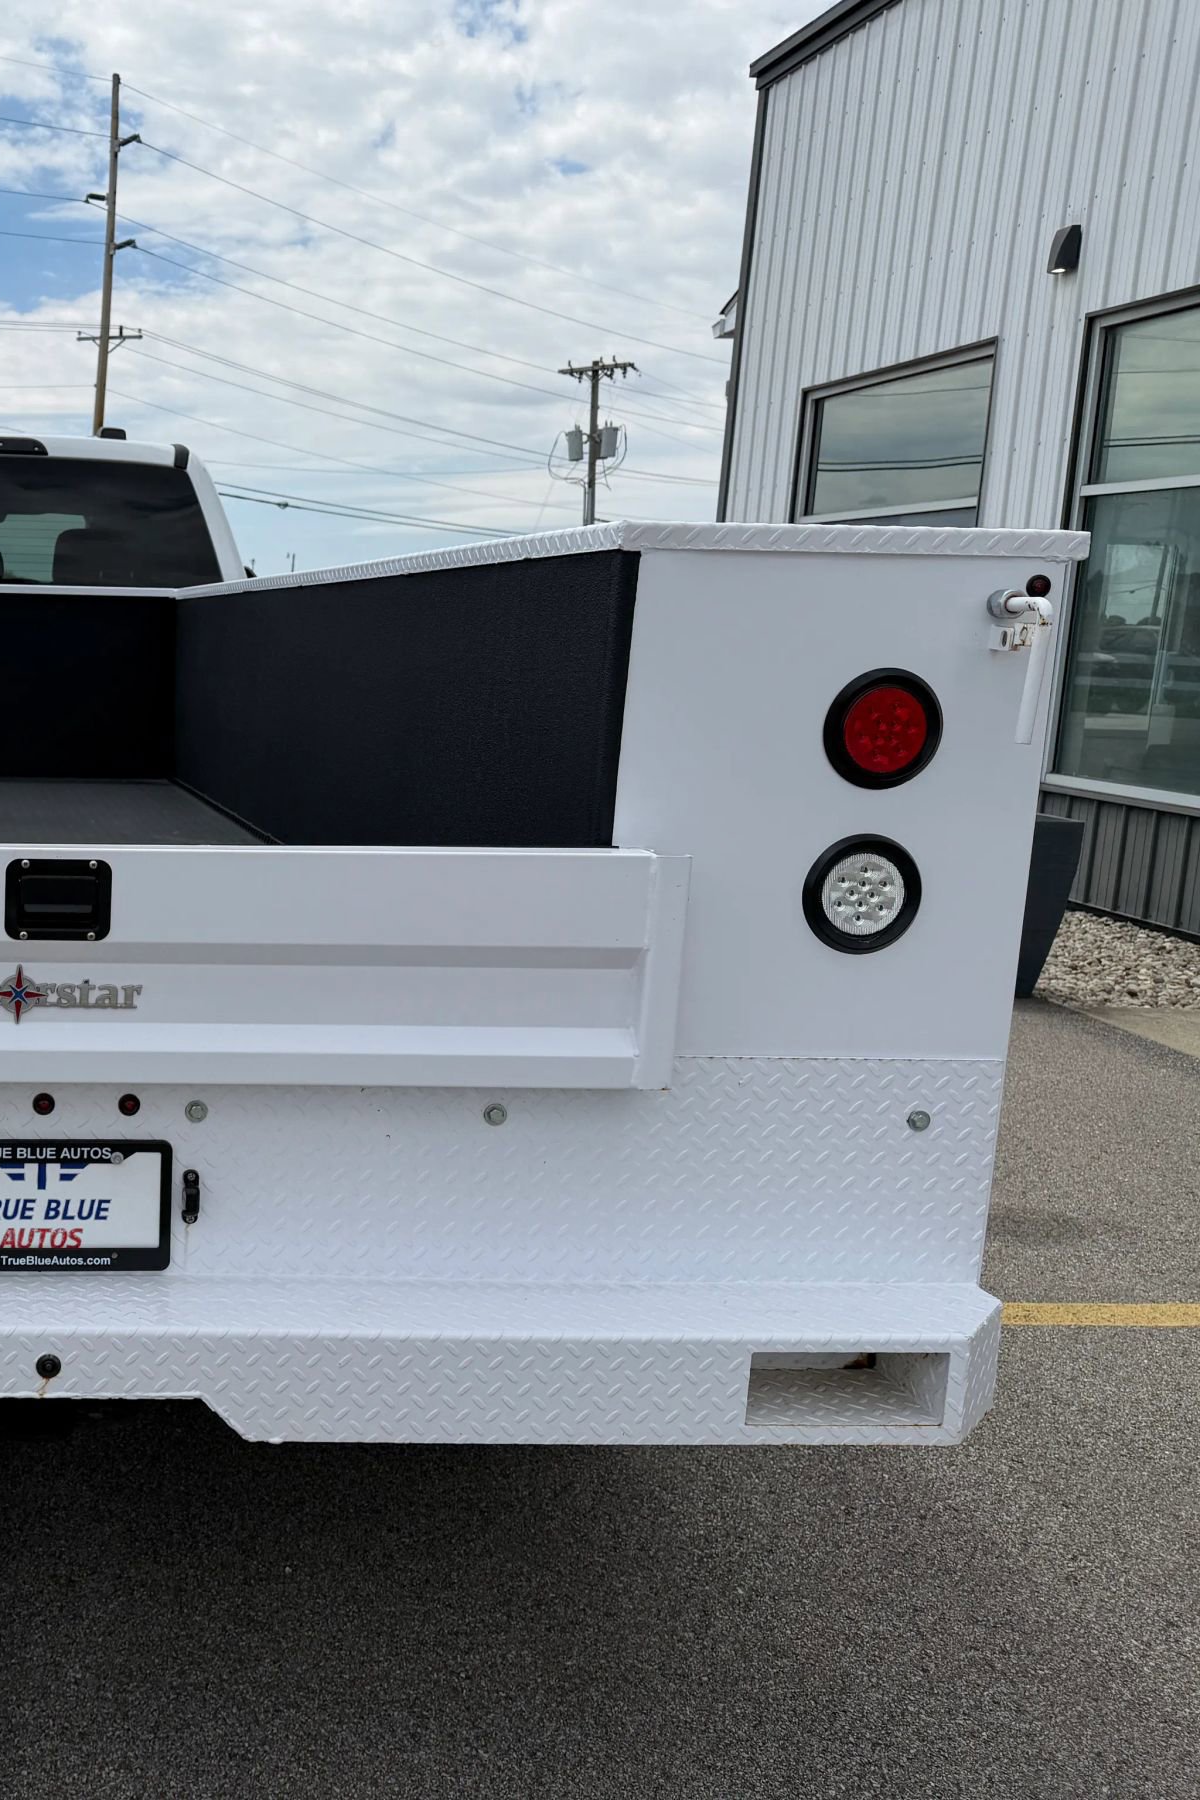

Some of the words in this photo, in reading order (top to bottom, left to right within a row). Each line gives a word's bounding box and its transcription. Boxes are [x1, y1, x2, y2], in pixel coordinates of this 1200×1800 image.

[16, 1147, 57, 1159] BLUE
[60, 1147, 111, 1160] AUTOS
[44, 1198, 112, 1221] BLUE
[0, 1227, 84, 1248] AUTOS
